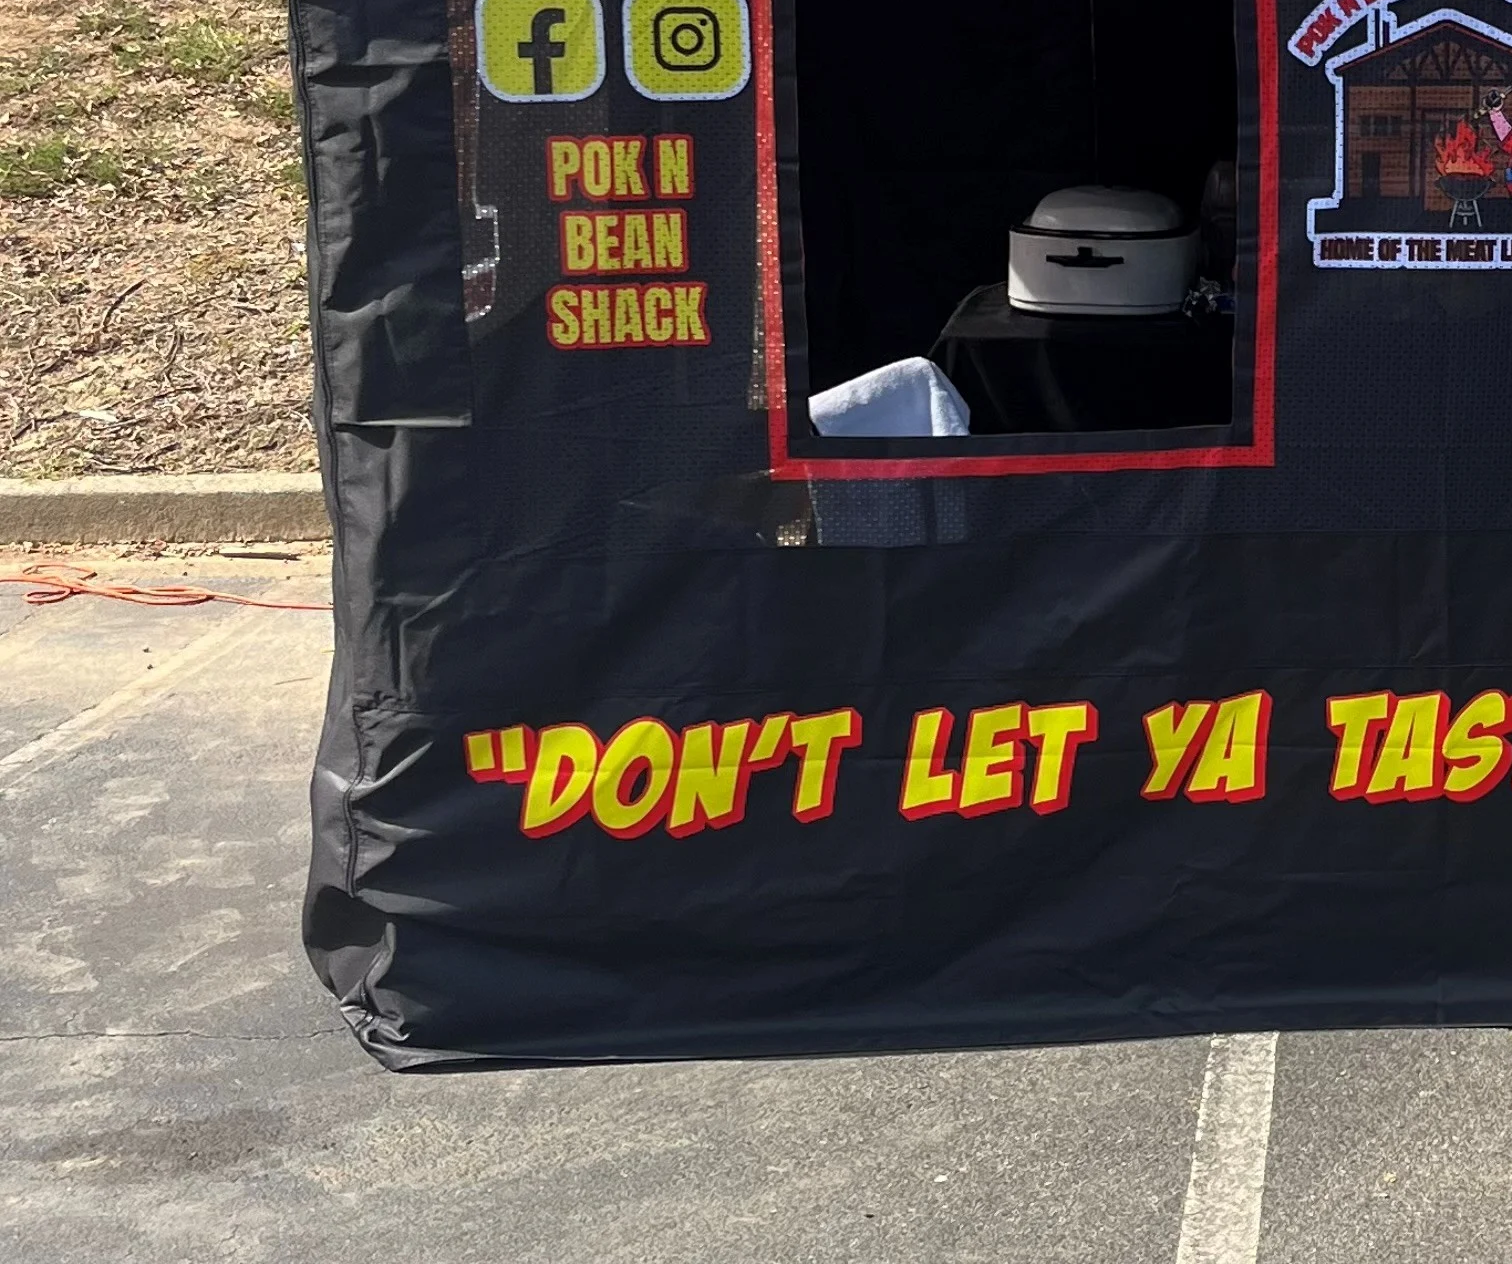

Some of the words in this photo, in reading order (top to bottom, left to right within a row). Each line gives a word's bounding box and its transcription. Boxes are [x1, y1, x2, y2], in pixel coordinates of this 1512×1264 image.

[1295, 7, 1343, 57] POK
[549, 137, 647, 198] POK
[656, 137, 693, 198] N
[563, 211, 686, 272] BEAN
[1319, 238, 1375, 262] HOME
[1377, 238, 1403, 262] OF
[1405, 238, 1442, 262] THE
[1444, 238, 1498, 262] MEAT
[548, 283, 709, 347] SHACK
[899, 701, 1097, 821] LET
[1141, 689, 1273, 803] YA
